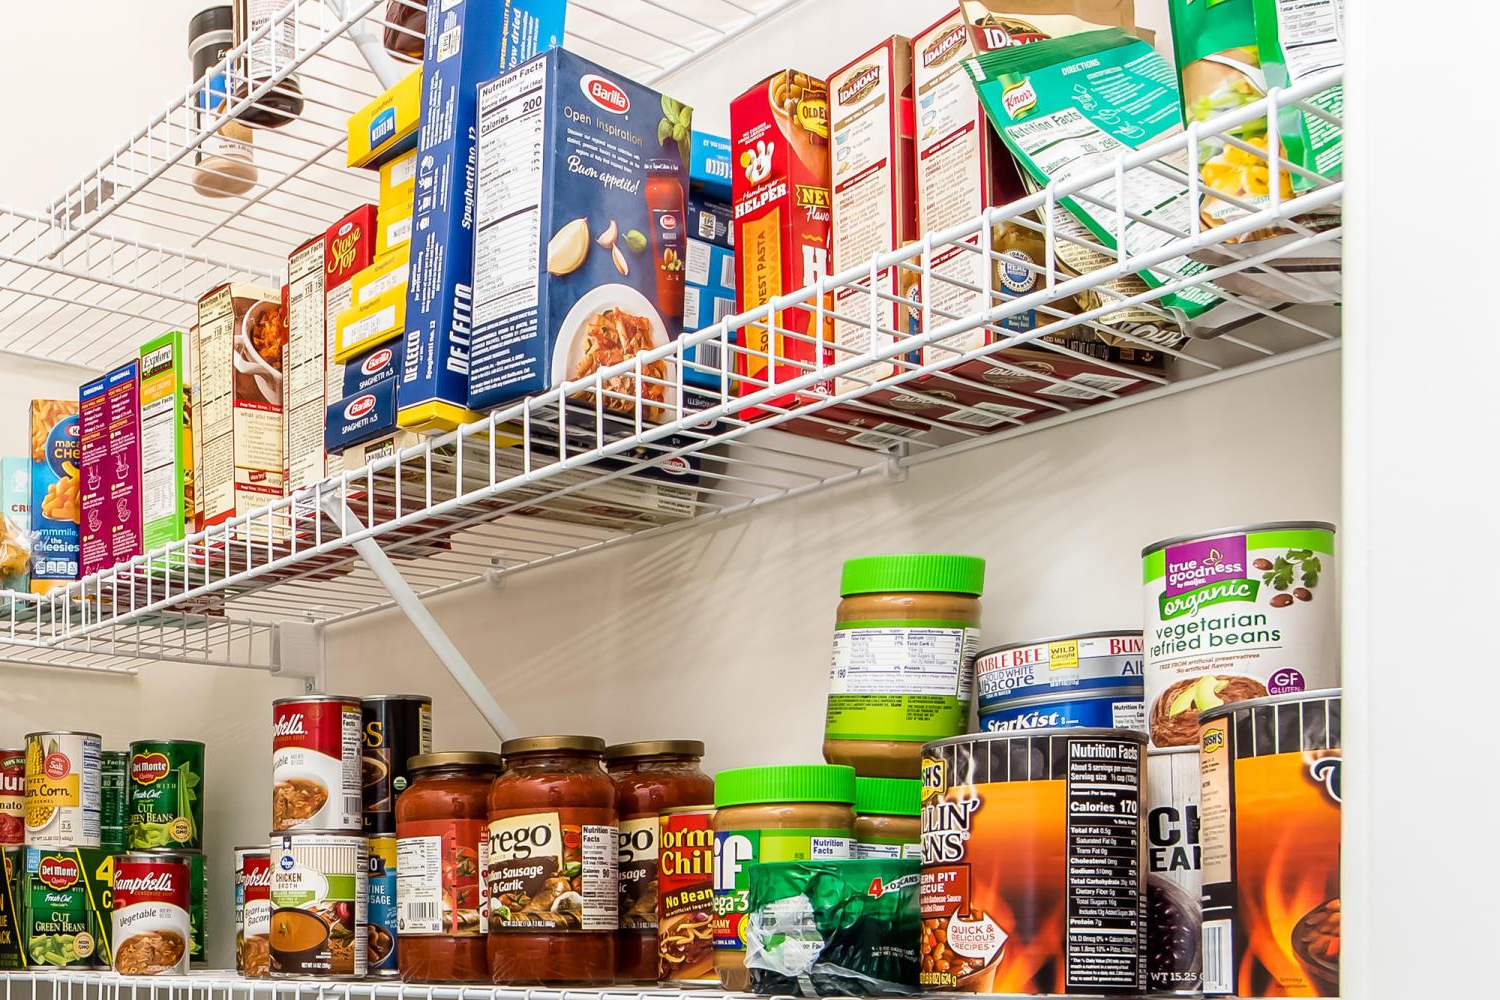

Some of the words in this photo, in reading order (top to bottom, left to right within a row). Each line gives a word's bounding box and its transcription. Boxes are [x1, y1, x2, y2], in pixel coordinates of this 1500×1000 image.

[924, 28, 965, 66] IDAHOAN
[1062, 59, 1100, 75] DIRECTIONS
[483, 74, 517, 96] Nutrition
[520, 62, 543, 78] Facts
[839, 69, 879, 105] IDAHOAN
[592, 83, 625, 107] Barilla
[1006, 89, 1033, 110] Knorr
[522, 96, 542, 113] 200
[803, 107, 818, 118] OLD
[481, 114, 509, 134] Calories
[564, 107, 591, 124] Open
[597, 118, 643, 146] Inspiration
[734, 183, 787, 218] HELPER
[143, 350, 171, 369] Explore
[1169, 560, 1197, 573] true
[1169, 560, 1243, 585] goodness
[1163, 582, 1251, 617] organic
[1155, 612, 1267, 640] vegetarian
[1150, 634, 1206, 657] refried
[1210, 626, 1281, 648] beans
[1050, 645, 1076, 654] WILD
[1050, 652, 1076, 660] Caught
[1013, 647, 1044, 666] BEE
[1275, 672, 1299, 687] GF
[1072, 745, 1116, 759] Nutrition
[49, 760, 64, 771] Salt
[1071, 773, 1094, 782] Serving
[1096, 774, 1107, 782] size
[1071, 802, 1115, 813] Calories
[1120, 800, 1137, 814] 170
[583, 826, 608, 835] Nutrition
[583, 835, 600, 843] Facts
[813, 839, 843, 847] Nutrition
[813, 847, 833, 855] Facts
[42, 866, 54, 877] Del
[54, 866, 77, 877] Monte
[276, 873, 301, 883] CHICKEN
[502, 865, 544, 880] Sausage
[938, 872, 957, 882] PIT
[499, 879, 523, 892] Garlic
[666, 897, 679, 909] No
[52, 912, 70, 922] CUT
[119, 907, 157, 928] Vegetable
[35, 921, 61, 932] GREEN
[62, 921, 85, 932] BEANS
[951, 925, 984, 935] QUICK
[951, 934, 996, 943] DELICIOUS
[955, 943, 992, 951] RECIPES
[1151, 972, 1168, 981] WT
[1170, 972, 1197, 982] 15.25
